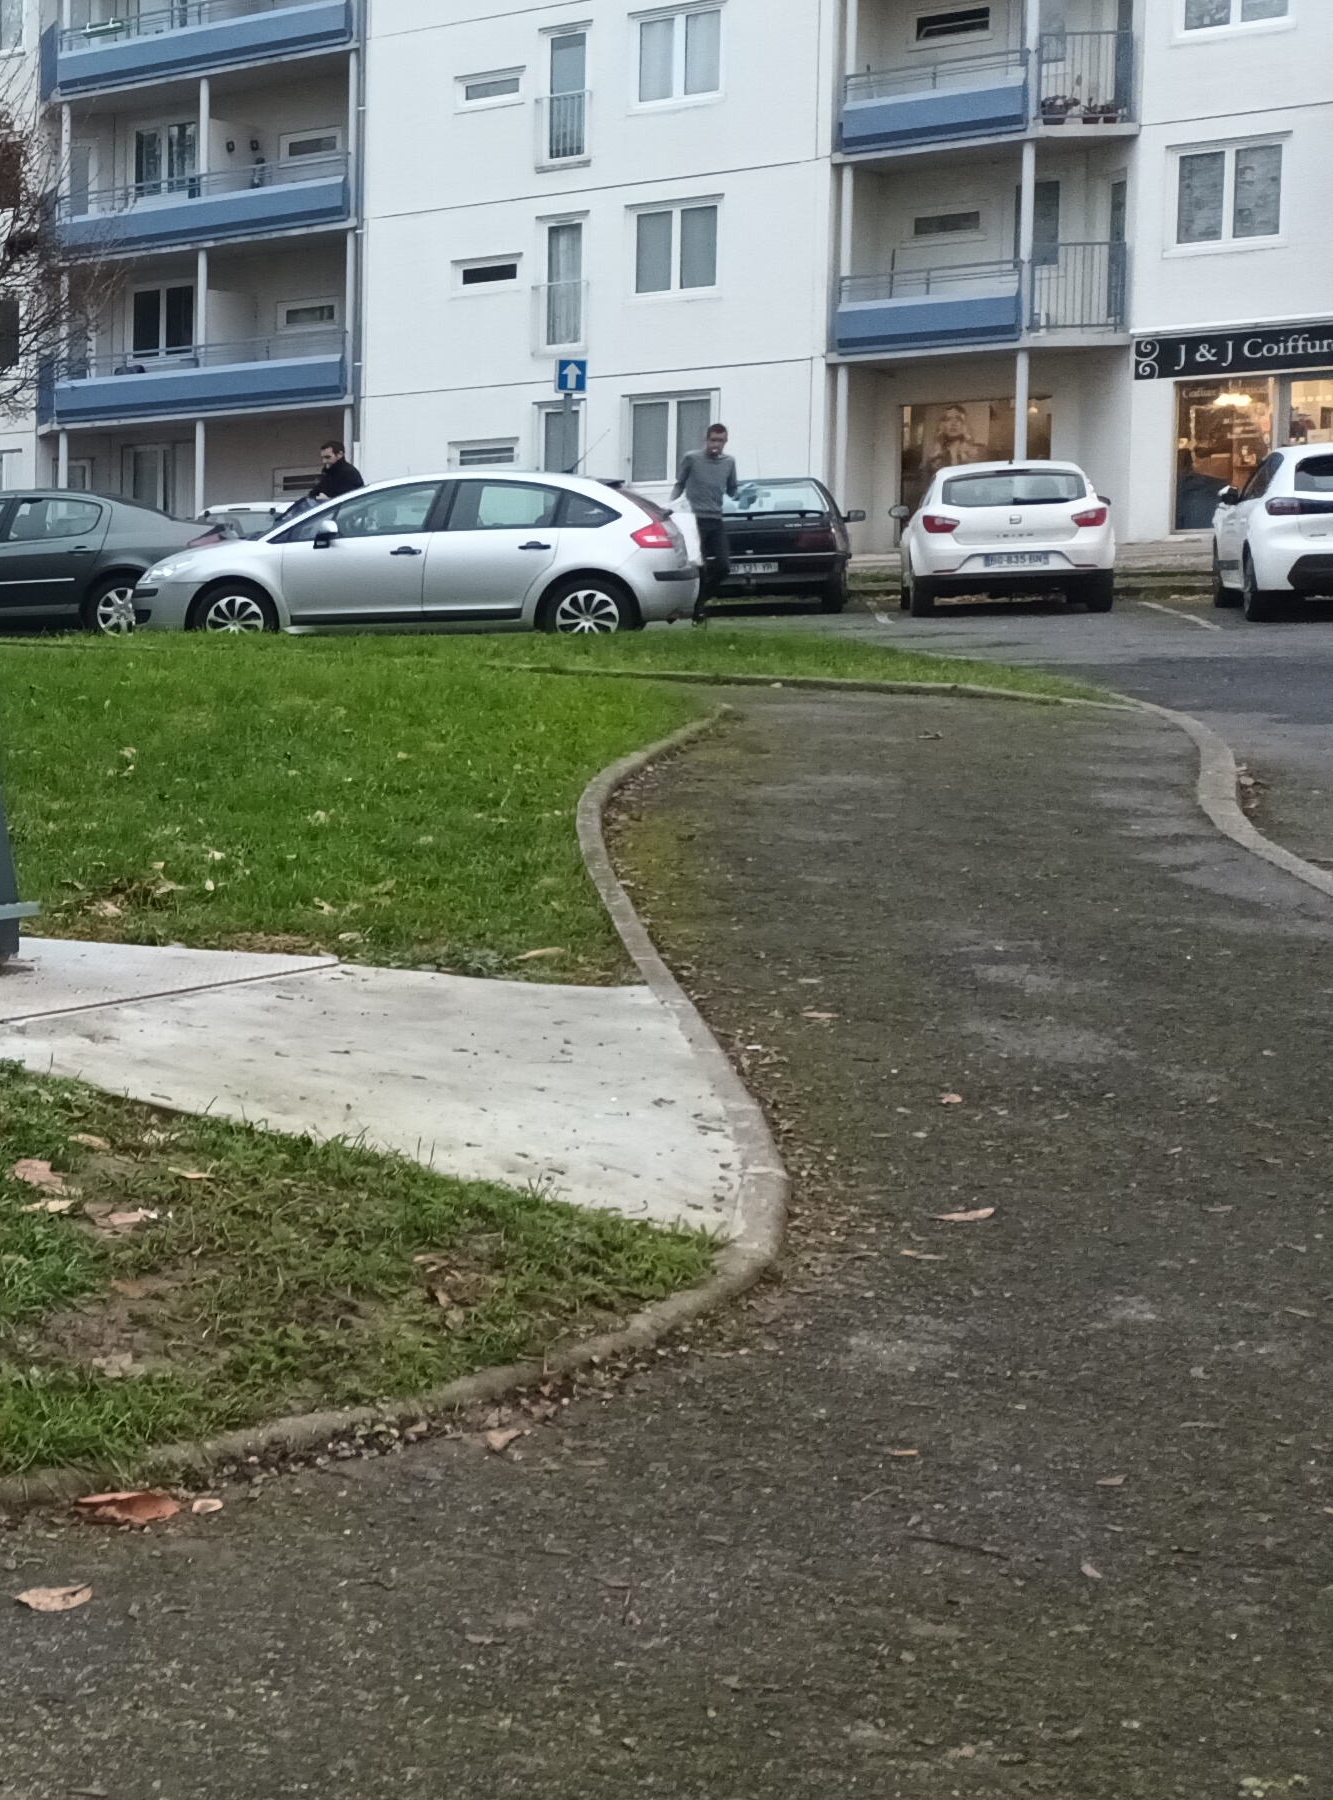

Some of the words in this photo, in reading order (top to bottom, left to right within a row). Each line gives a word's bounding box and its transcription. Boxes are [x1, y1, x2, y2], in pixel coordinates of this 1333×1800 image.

[1174, 344, 1186, 370] J
[1195, 343, 1218, 362] &
[1221, 340, 1235, 366] J
